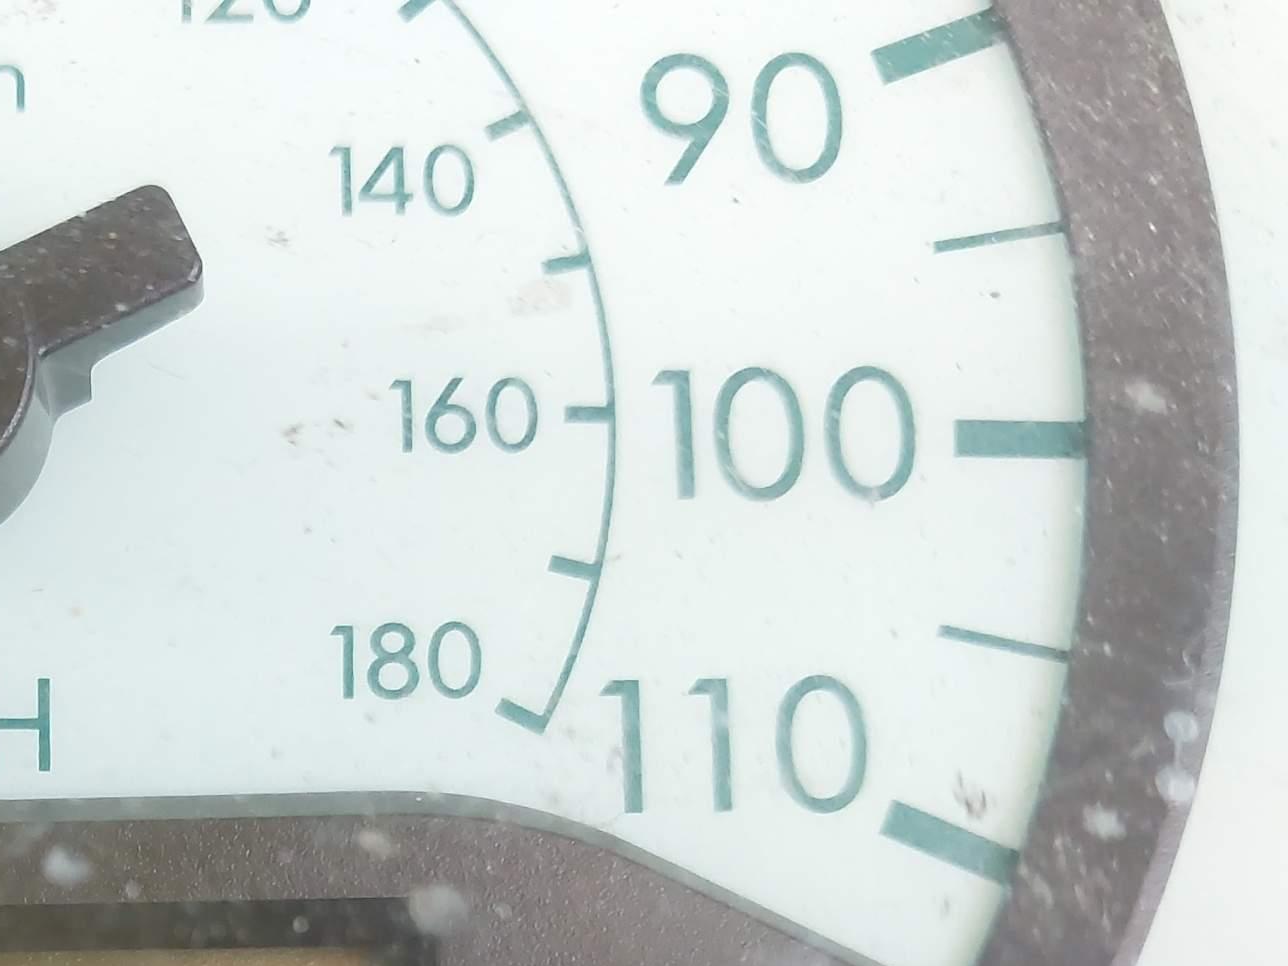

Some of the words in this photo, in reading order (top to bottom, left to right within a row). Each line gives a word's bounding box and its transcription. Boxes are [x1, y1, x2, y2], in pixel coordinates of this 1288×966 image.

[641, 51, 842, 183] 90
[330, 145, 475, 215] 140
[390, 379, 536, 452] 160
[653, 366, 914, 501] 100
[330, 621, 481, 698] 180
[599, 674, 866, 812] 110
